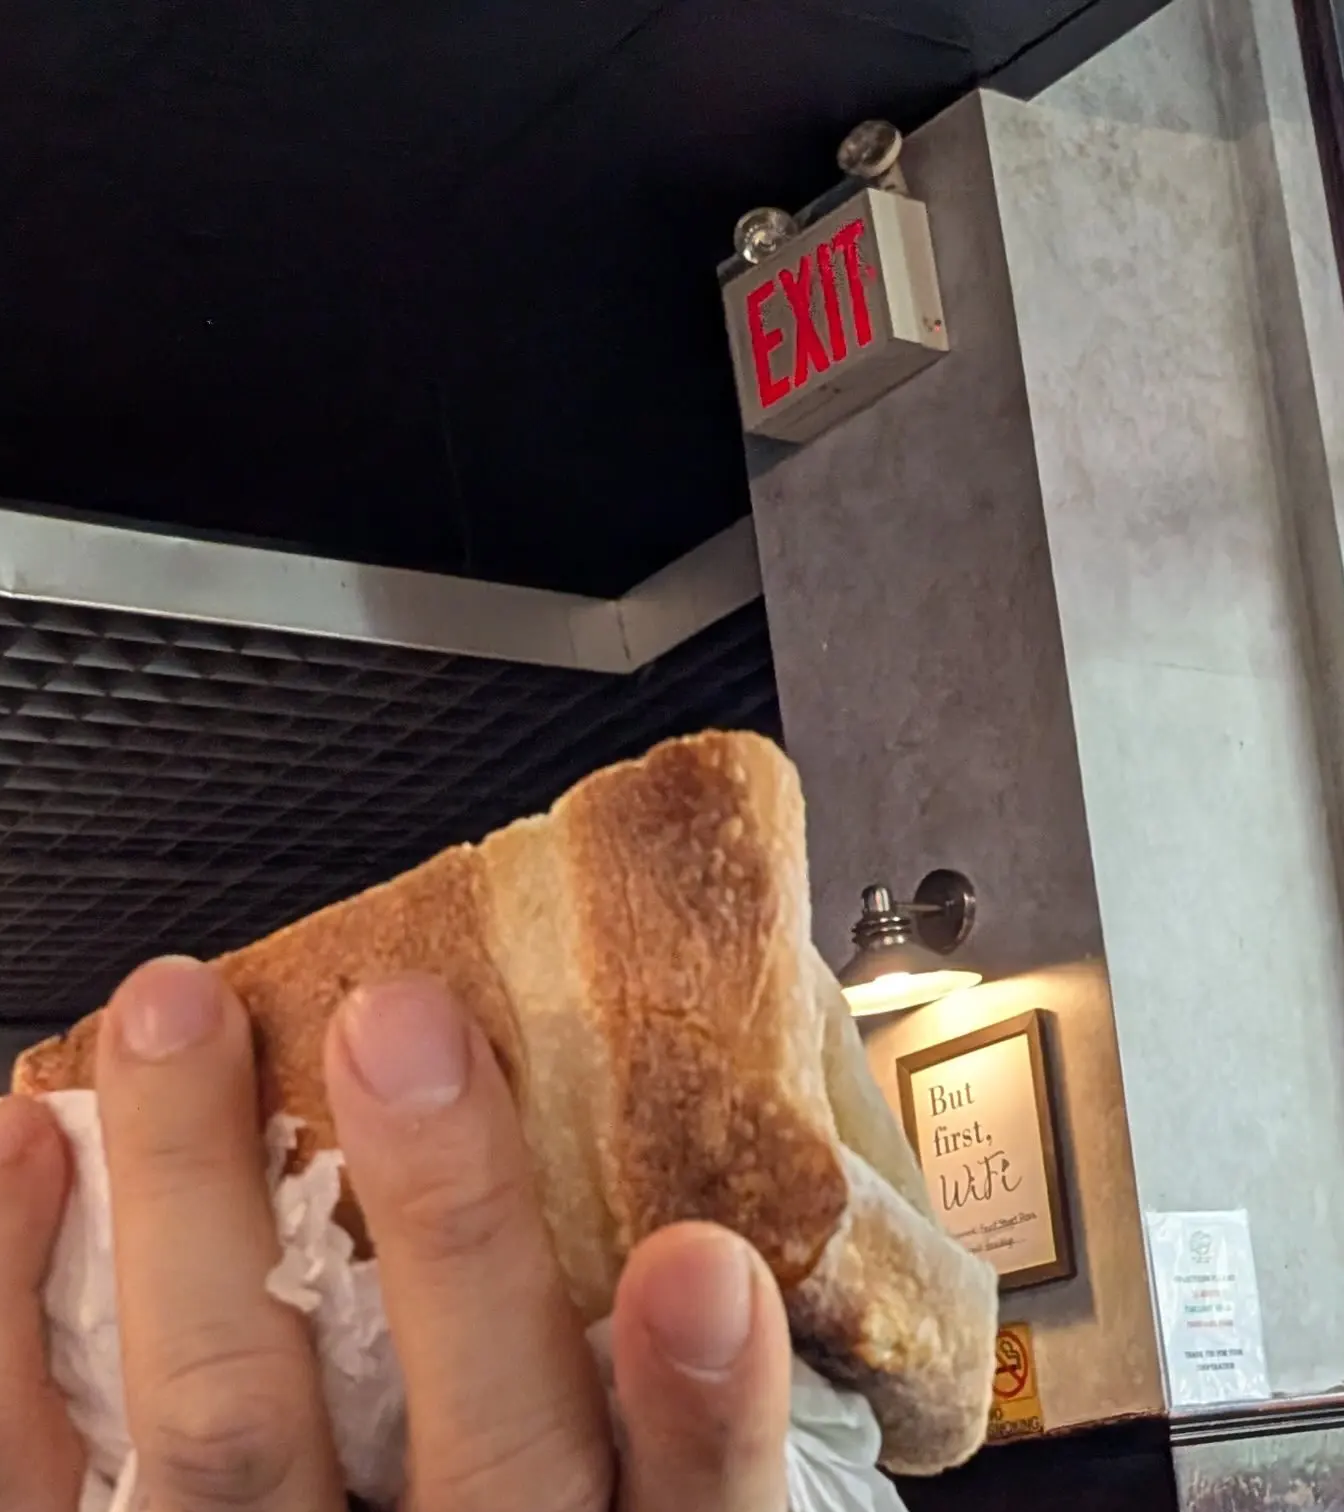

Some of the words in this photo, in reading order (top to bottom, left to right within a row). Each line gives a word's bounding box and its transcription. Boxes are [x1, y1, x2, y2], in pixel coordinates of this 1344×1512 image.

[746, 218, 872, 408] EXIT
[928, 1082, 975, 1117] But
[933, 1120, 993, 1157] first,
